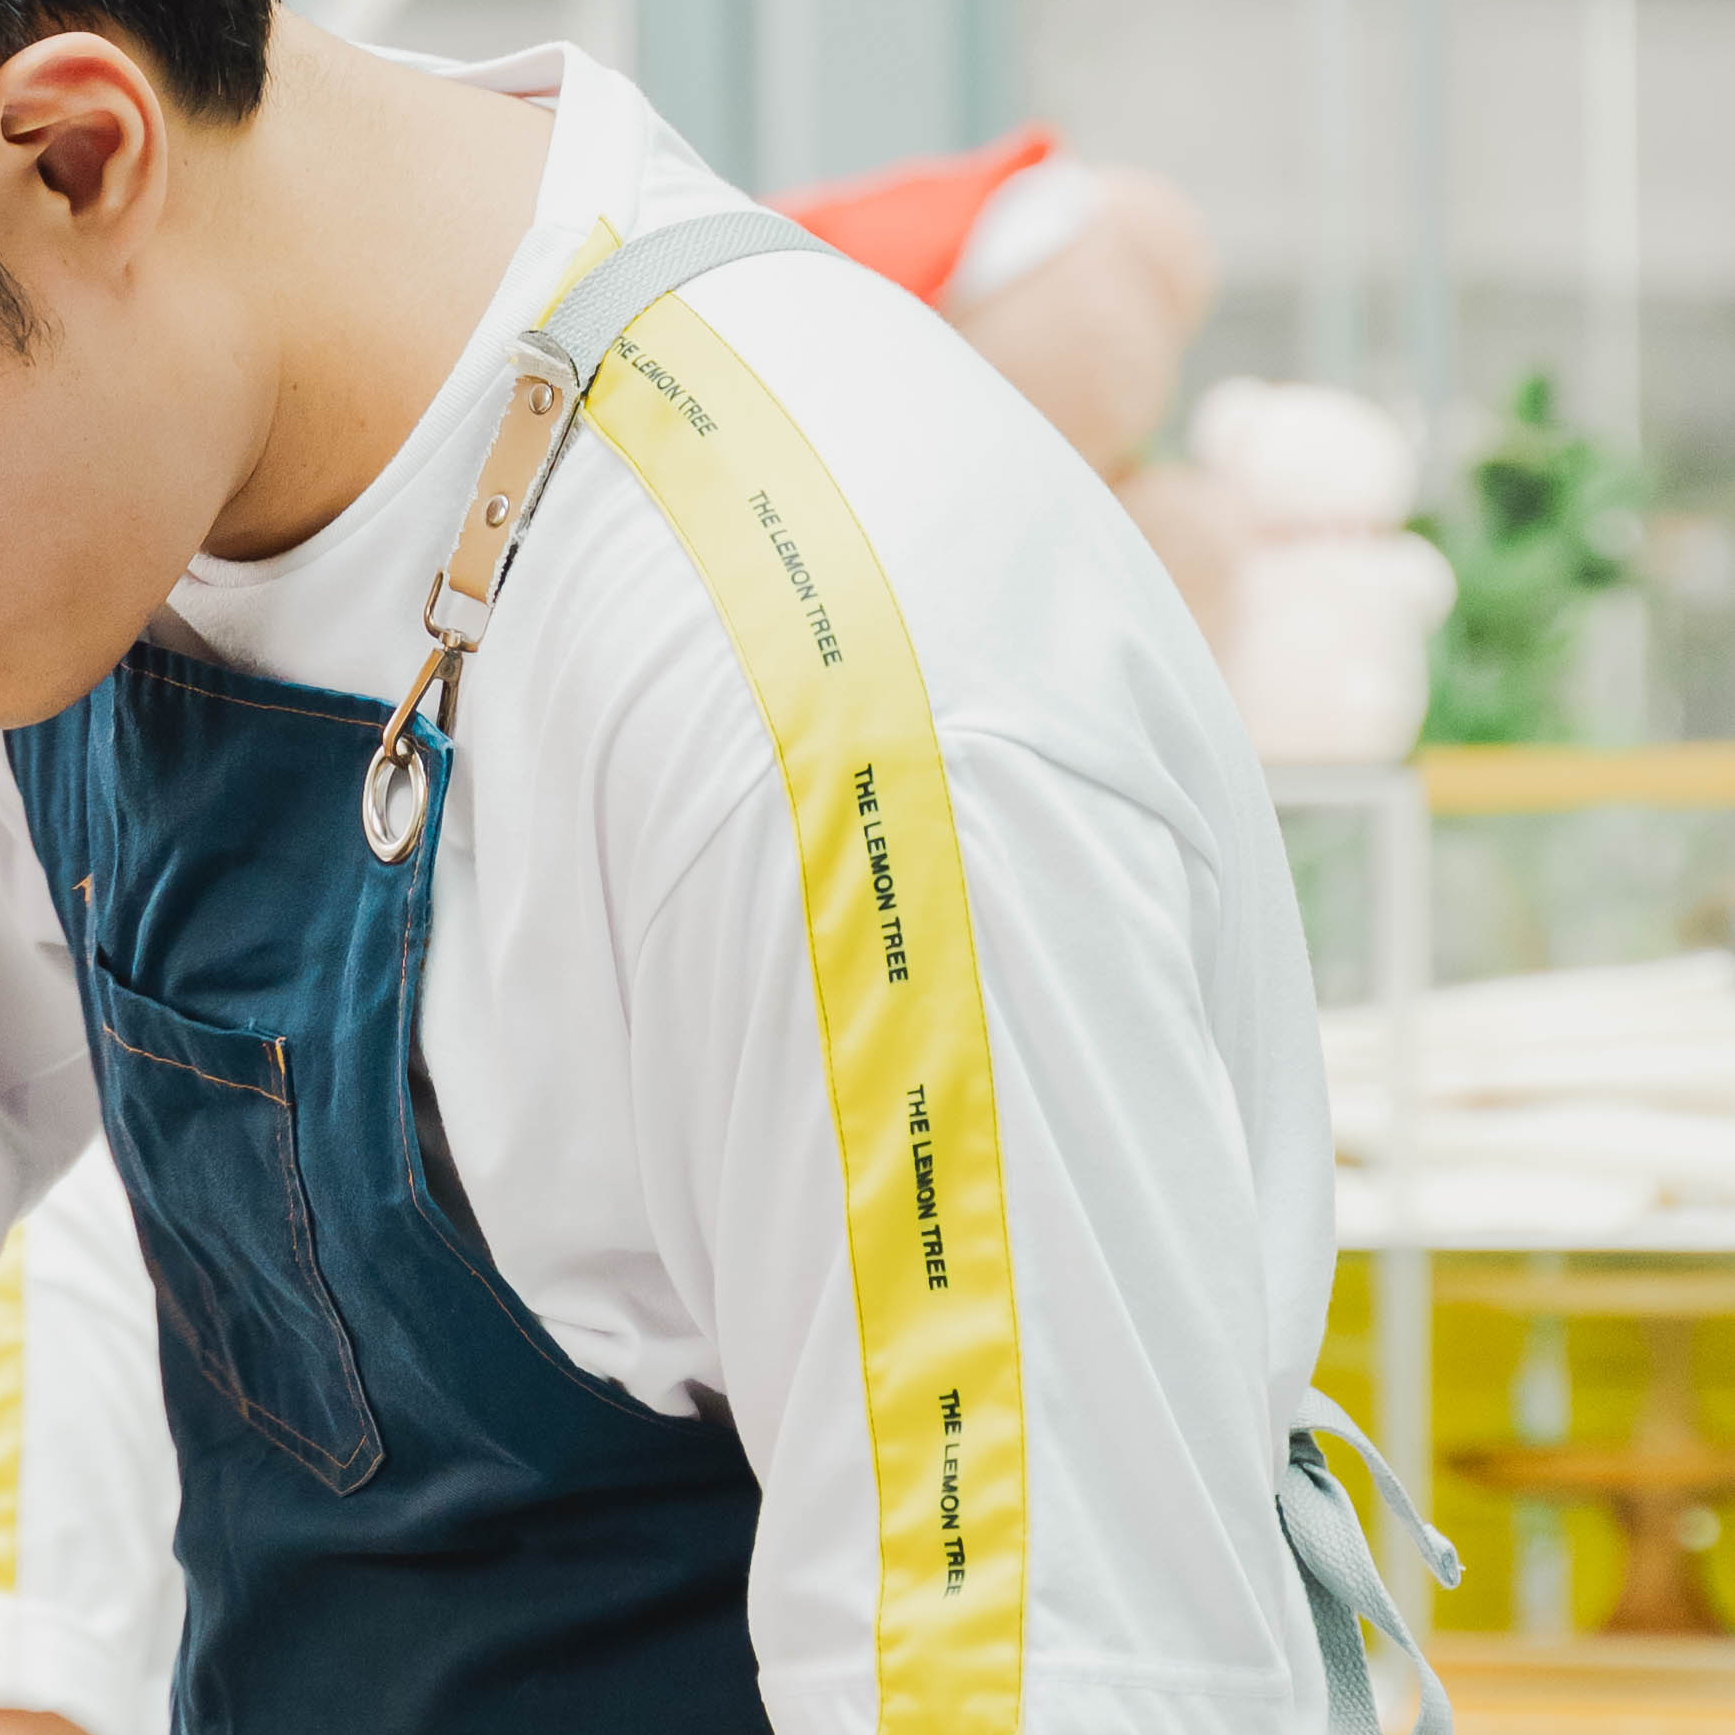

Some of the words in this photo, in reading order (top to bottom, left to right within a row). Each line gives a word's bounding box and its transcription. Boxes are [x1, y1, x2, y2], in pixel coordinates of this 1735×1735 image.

[631, 353, 687, 402] LEMON
[678, 395, 719, 438] TREE
[748, 489, 782, 528] THE
[769, 529, 818, 602] LEMON
[806, 603, 843, 668] TREE
[854, 763, 879, 816] THE
[863, 821, 897, 911] LEMON
[881, 916, 909, 984] TREE
[907, 1084, 930, 1135] THE
[912, 1140, 938, 1220] LEMON
[921, 1224, 948, 1290] TREE
[939, 1388, 962, 1436] THE
[940, 1443, 961, 1530] LEMON
[943, 1536, 966, 1600] TREE
